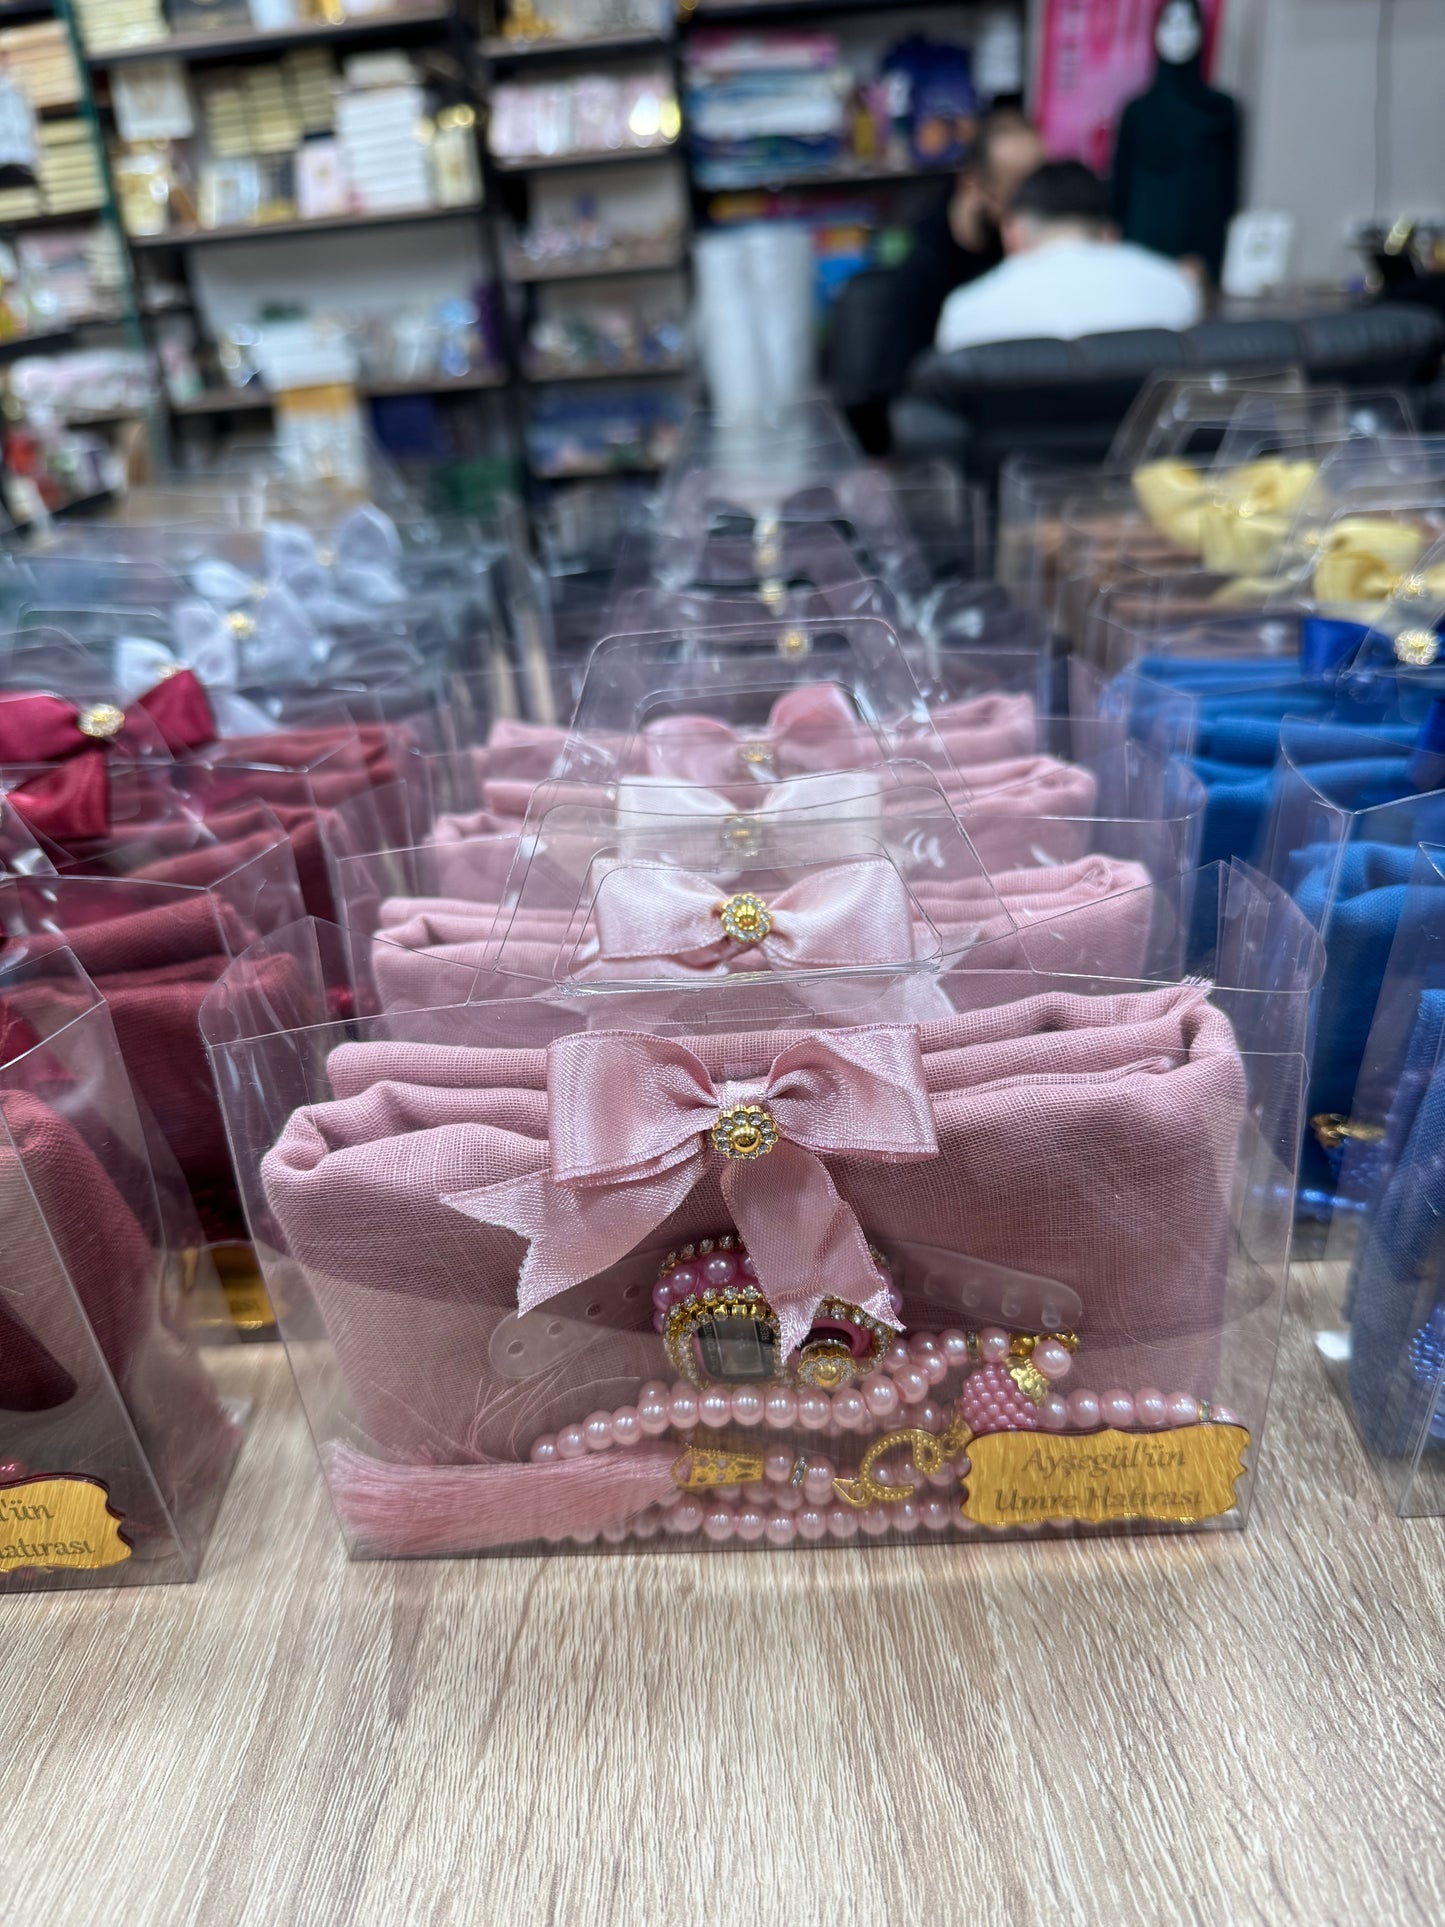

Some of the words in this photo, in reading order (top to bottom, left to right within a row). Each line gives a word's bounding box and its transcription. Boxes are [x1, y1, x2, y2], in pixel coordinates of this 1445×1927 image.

[1021, 1440, 1186, 1479] Ayşegül'ün
[994, 1488, 1078, 1513] Umre
[1085, 1486, 1202, 1511] Hatırası
[0, 1537, 96, 1560] atırası
